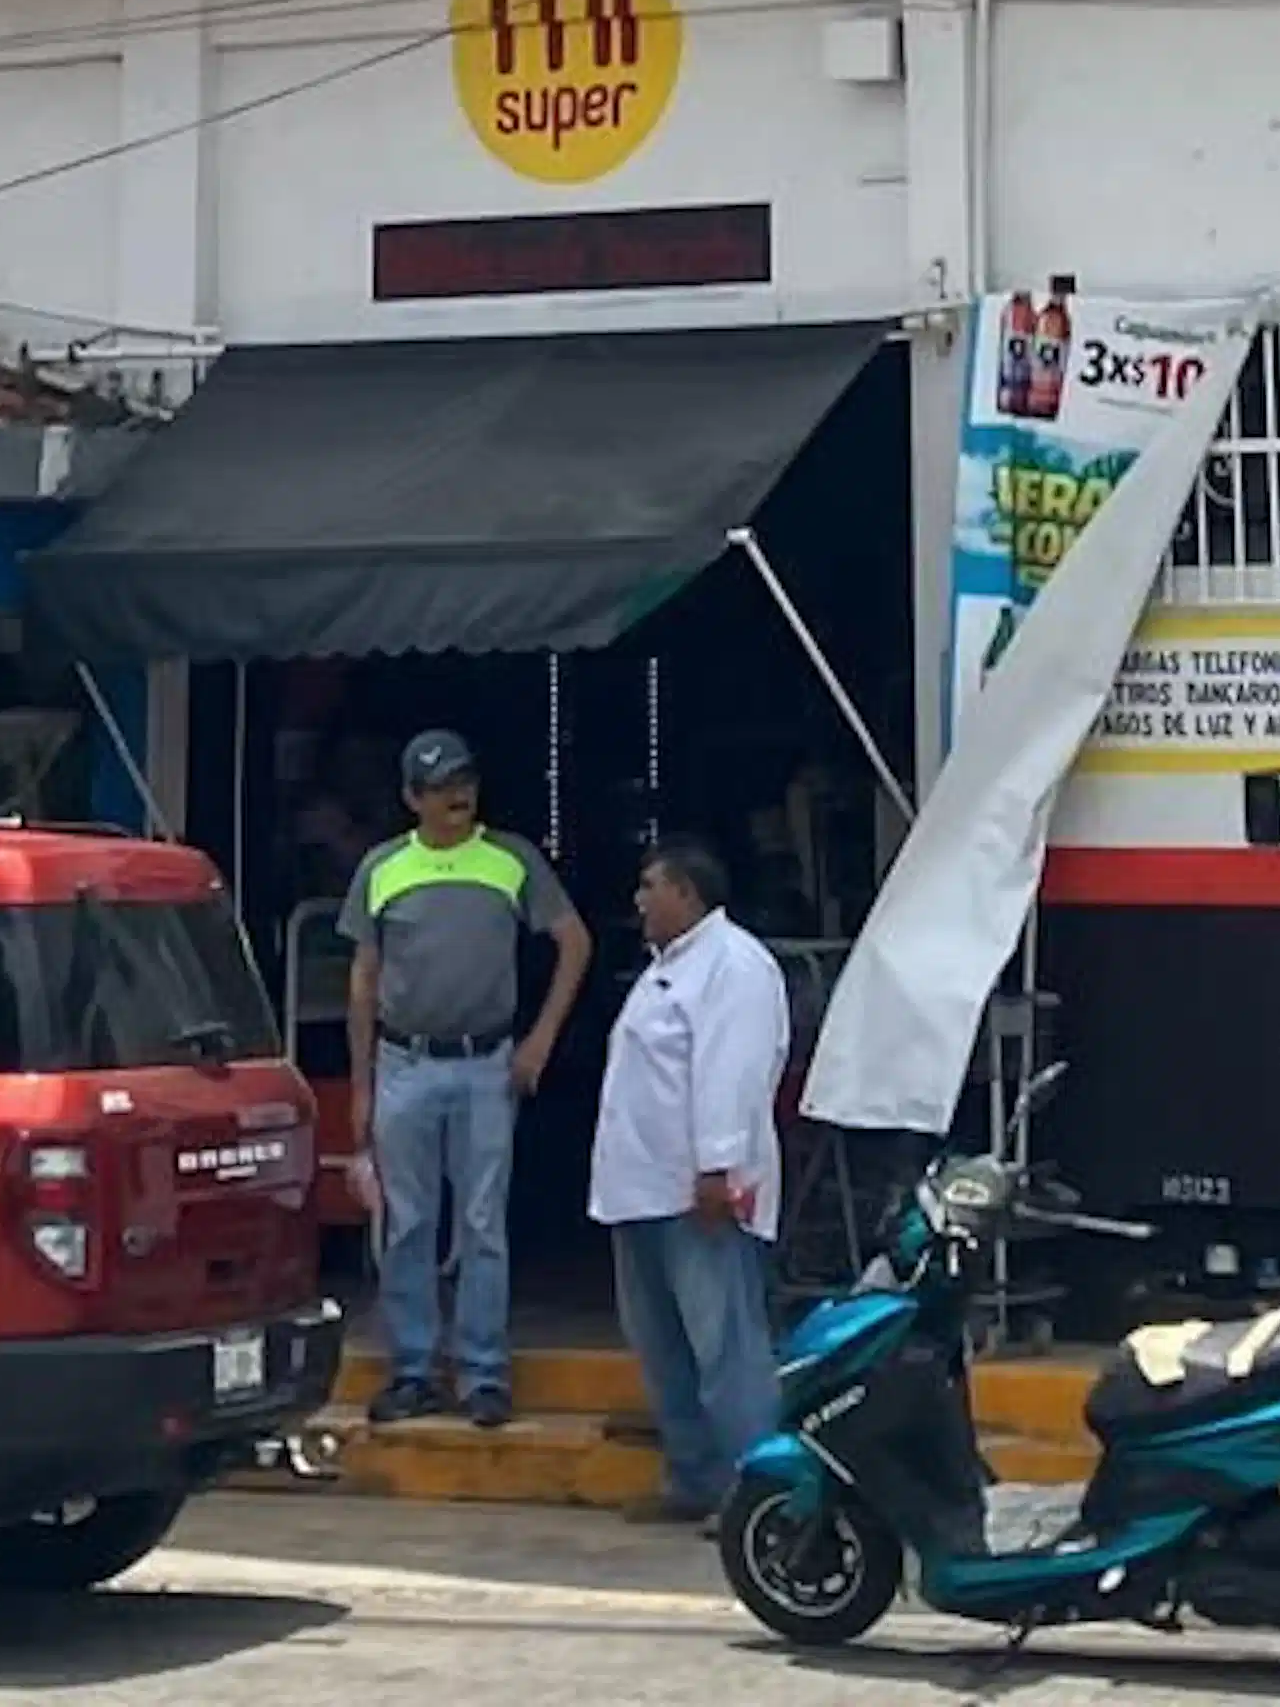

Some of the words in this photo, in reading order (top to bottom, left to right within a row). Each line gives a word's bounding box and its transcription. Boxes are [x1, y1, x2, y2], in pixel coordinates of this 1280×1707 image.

[496, 83, 638, 150] super
[1122, 651, 1181, 675] ARGAS
[1112, 682, 1172, 705] TIROS
[1101, 711, 1153, 736] AGOS
[1164, 710, 1188, 736] DE
[1195, 713, 1234, 736] LUZ
[1243, 713, 1258, 735] Y
